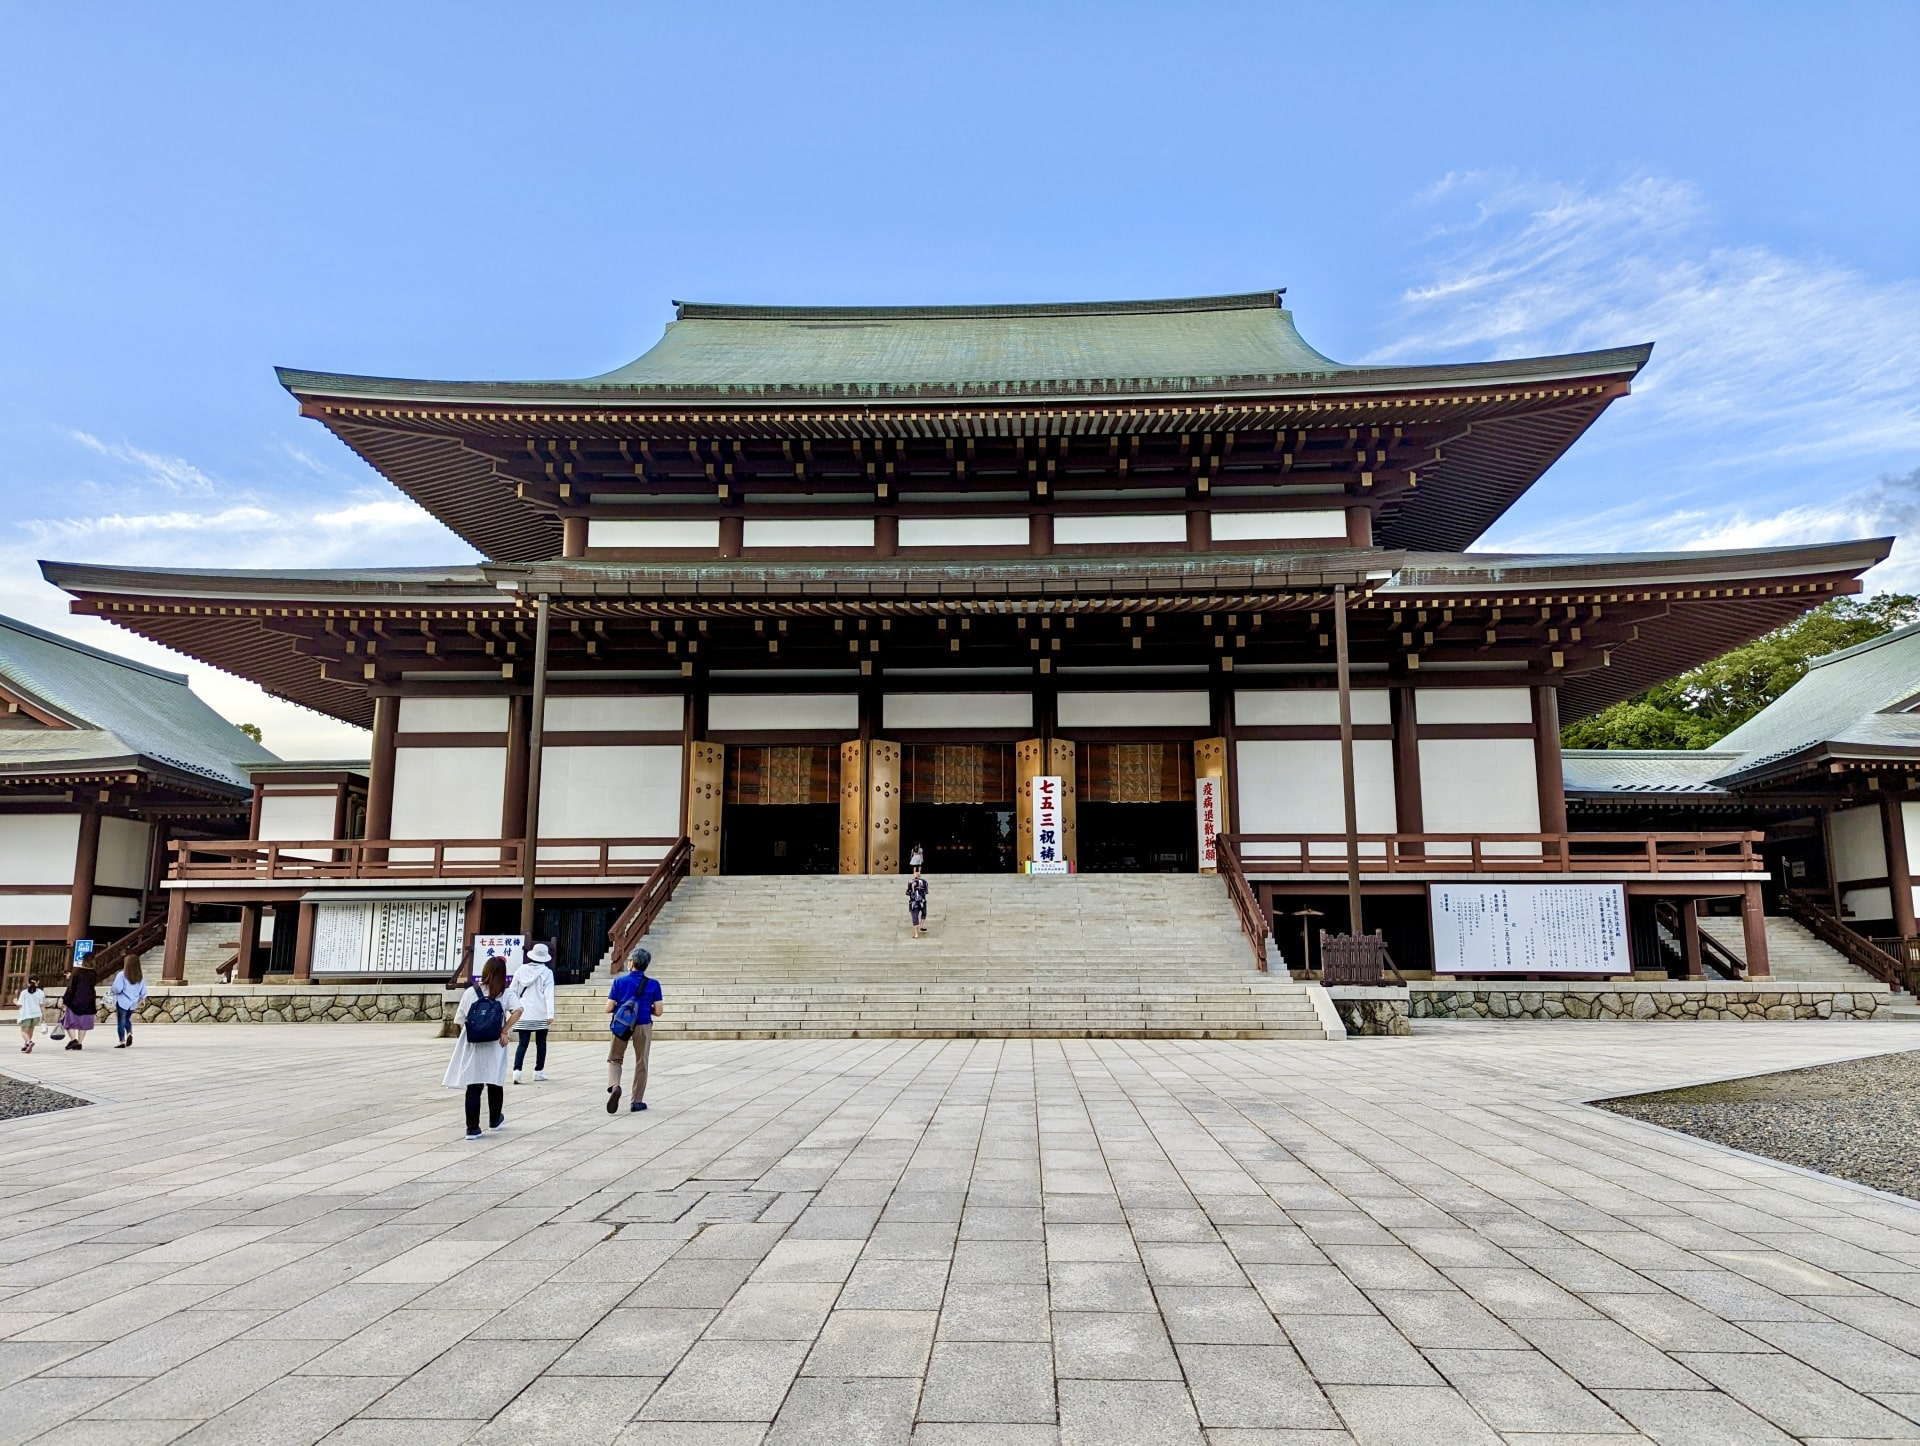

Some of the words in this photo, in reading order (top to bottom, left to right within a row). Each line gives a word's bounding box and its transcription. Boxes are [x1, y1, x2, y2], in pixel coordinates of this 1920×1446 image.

[1039, 779, 1055, 861] 七五三祝祷
[1203, 782, 1216, 861] 疫病退散祈願
[486, 947, 512, 956] 受付
